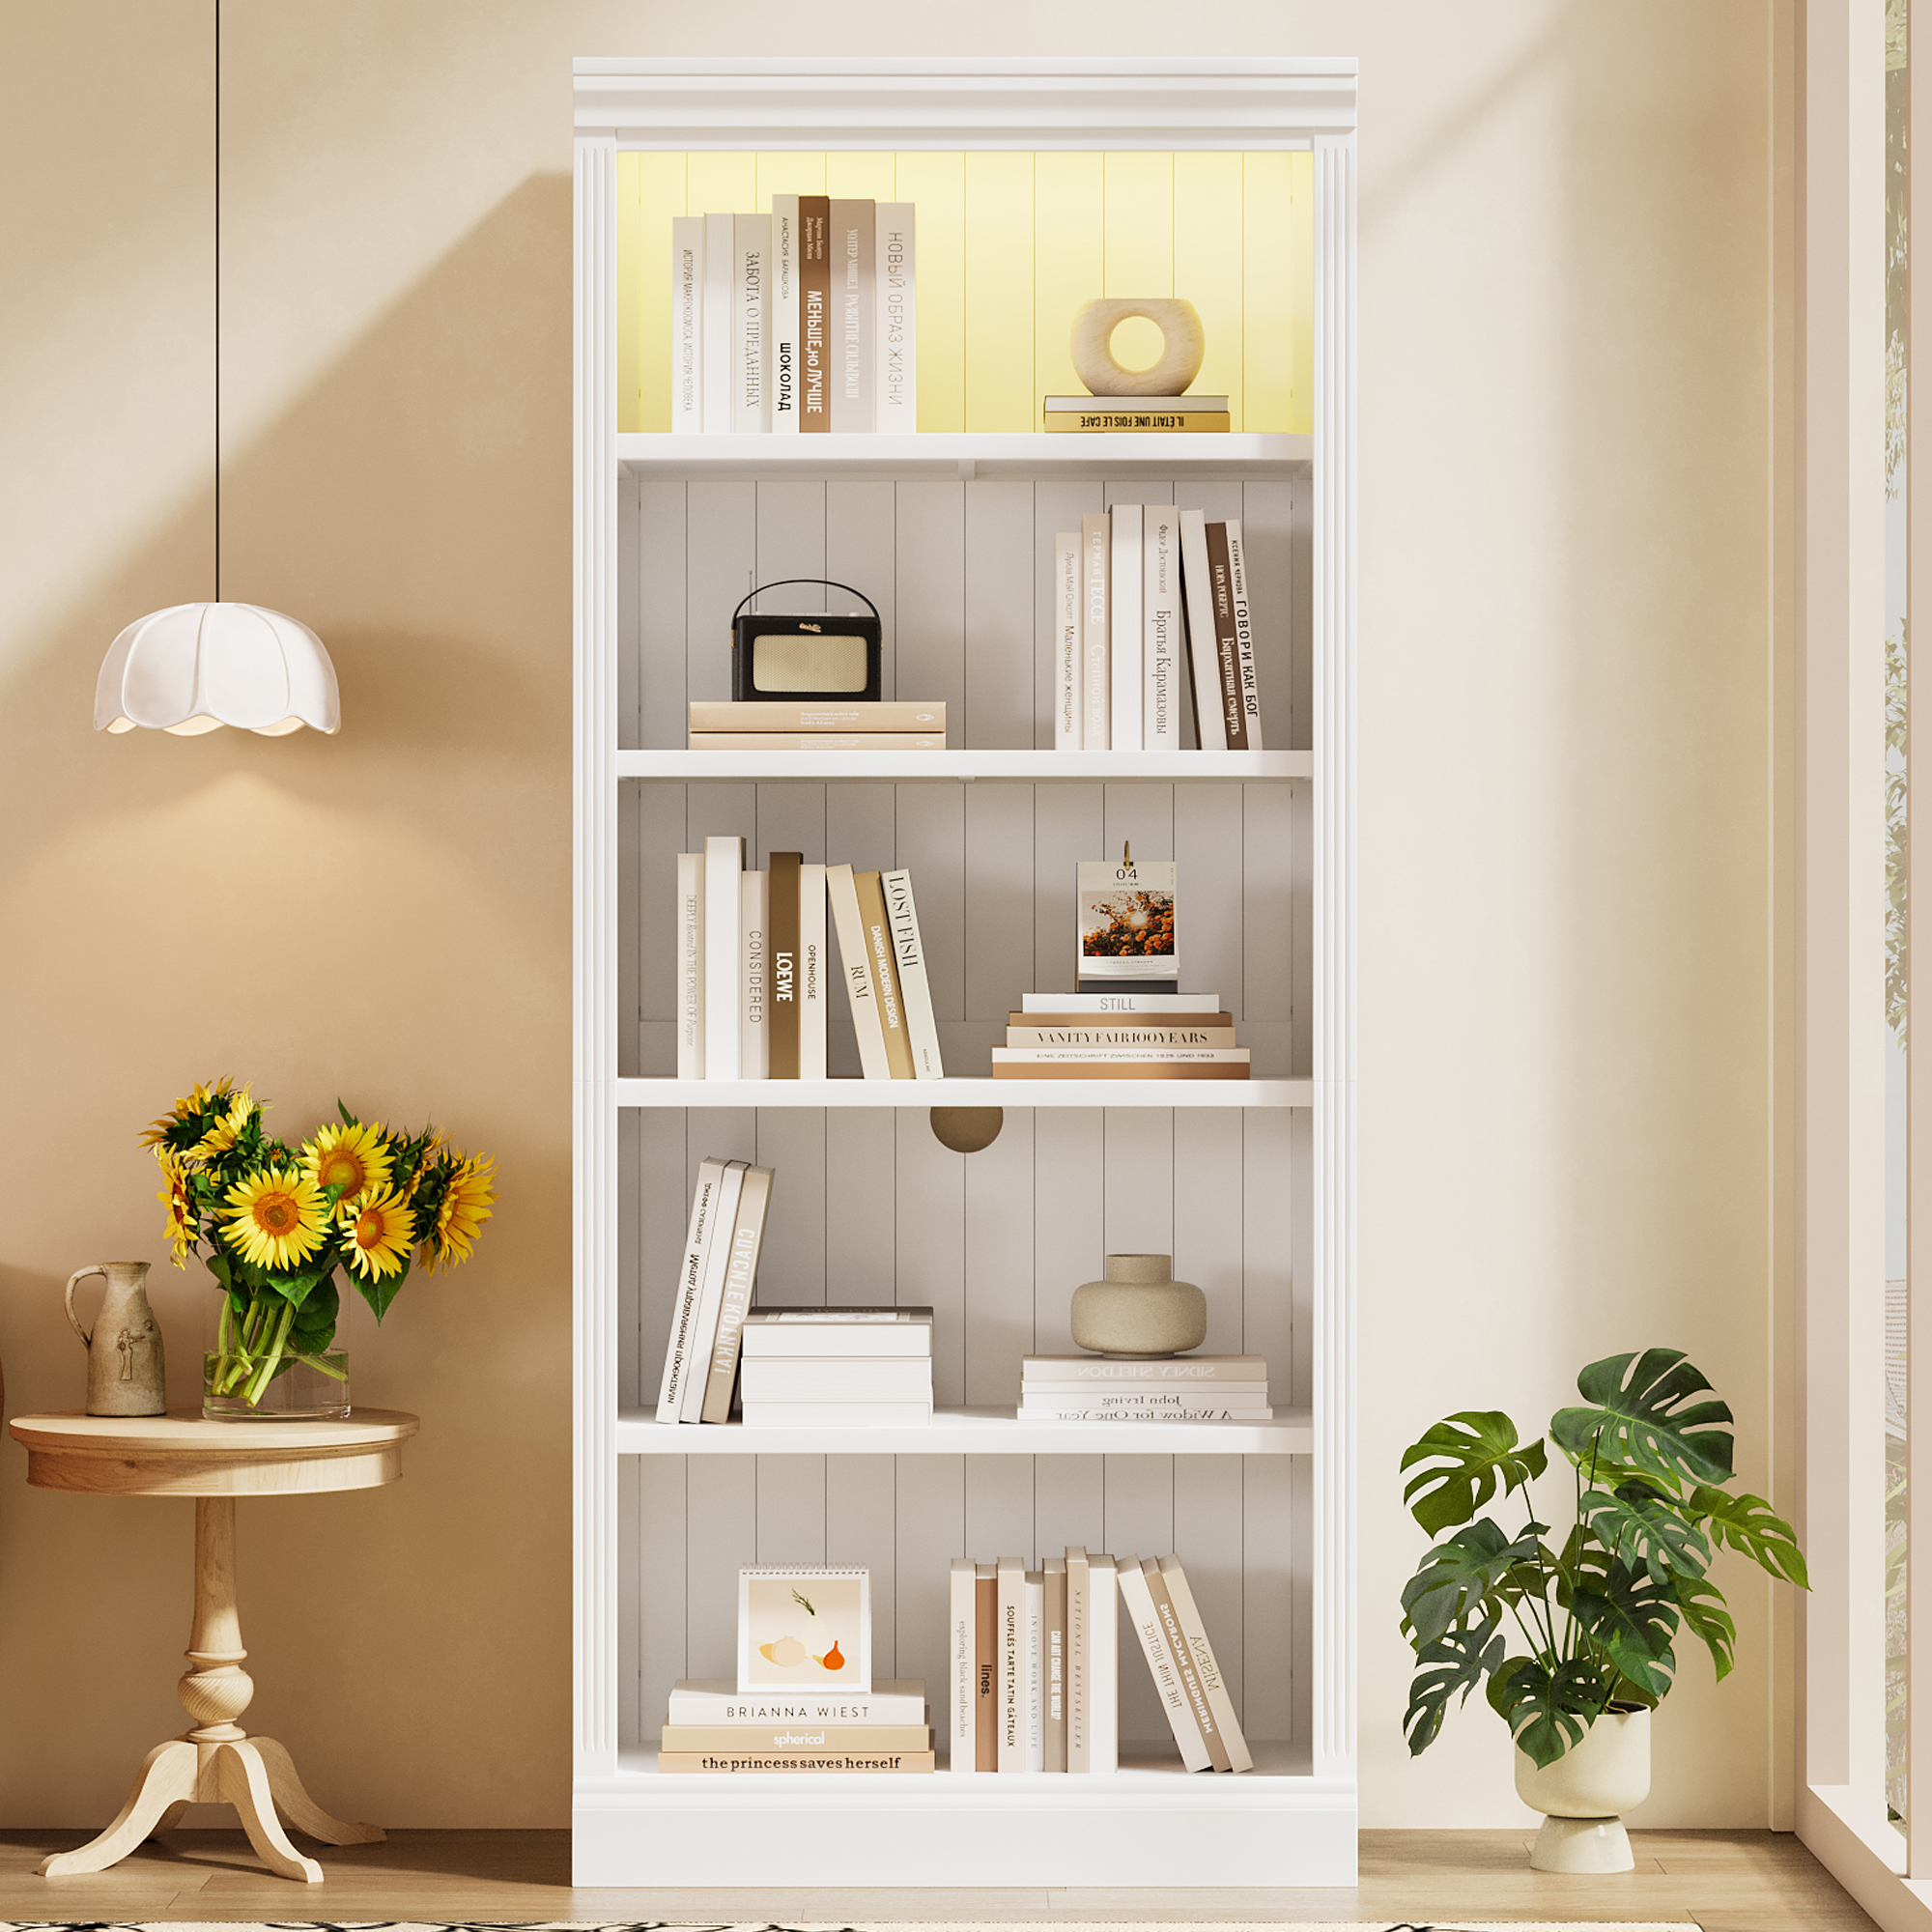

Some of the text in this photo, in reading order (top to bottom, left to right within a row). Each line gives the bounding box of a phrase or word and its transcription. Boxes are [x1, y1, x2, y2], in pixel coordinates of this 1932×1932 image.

[683, 250, 693, 280] ИСТОРИЯ
[745, 251, 760, 408] ЗАБОТА О ПРЕДАННЫХ
[888, 232, 905, 406] НОВЫЙ ОБРАЗ ЖИЗНИ
[683, 343, 693, 375] ИСТОРИЯ
[778, 343, 791, 412] ШОКОЛАД
[808, 368, 822, 413] ЛУЧШЕ
[683, 377, 693, 412] ЧЕЛОВЕКА
[1080, 416, 1184, 429] IL ÉTAIT UNE FOIS LE CAFÉ
[1065, 553, 1074, 575] Луиза
[1091, 531, 1104, 624] ГЕРМАН ГЕССЕ
[1151, 611, 1171, 733] Братья Карамазовы
[1236, 600, 1258, 718] ГОВОРИ КАК БОГ
[1064, 626, 1075, 733] Маленькие женщины
[1221, 638, 1238, 735] Бархатная смерть
[1116, 868, 1138, 879] 04
[686, 895, 696, 922] DEEPLY
[889, 876, 918, 968] LOST FISH
[686, 923, 696, 948] Rooted
[686, 959, 696, 974] THE
[749, 930, 762, 1023] CONSIDERED
[777, 952, 792, 1002] LOEWE
[808, 945, 816, 1000] OPENHOUSE
[850, 966, 868, 999] RUM
[871, 925, 899, 1029] DANISH MODERN DESIGN
[686, 977, 696, 1006] POWER
[1099, 998, 1136, 1010] STILL
[686, 1007, 696, 1017] OF
[1008, 1605, 1017, 1647] SOUFFLÉS
[1051, 1631, 1062, 1643] CAN
[1051, 1644, 1062, 1656] ART
[957, 1621, 968, 1737] exploring black sand beaches
[980, 1664, 992, 1698] lines.
[1051, 1658, 1062, 1682] CHANGE
[1051, 1683, 1062, 1694] THE
[726, 1707, 869, 1718] BRIANNA WIEST
[774, 1731, 825, 1747] spherical
[702, 1758, 728, 1768] the
[730, 1757, 798, 1771] princess
[845, 1757, 901, 1768] herself
